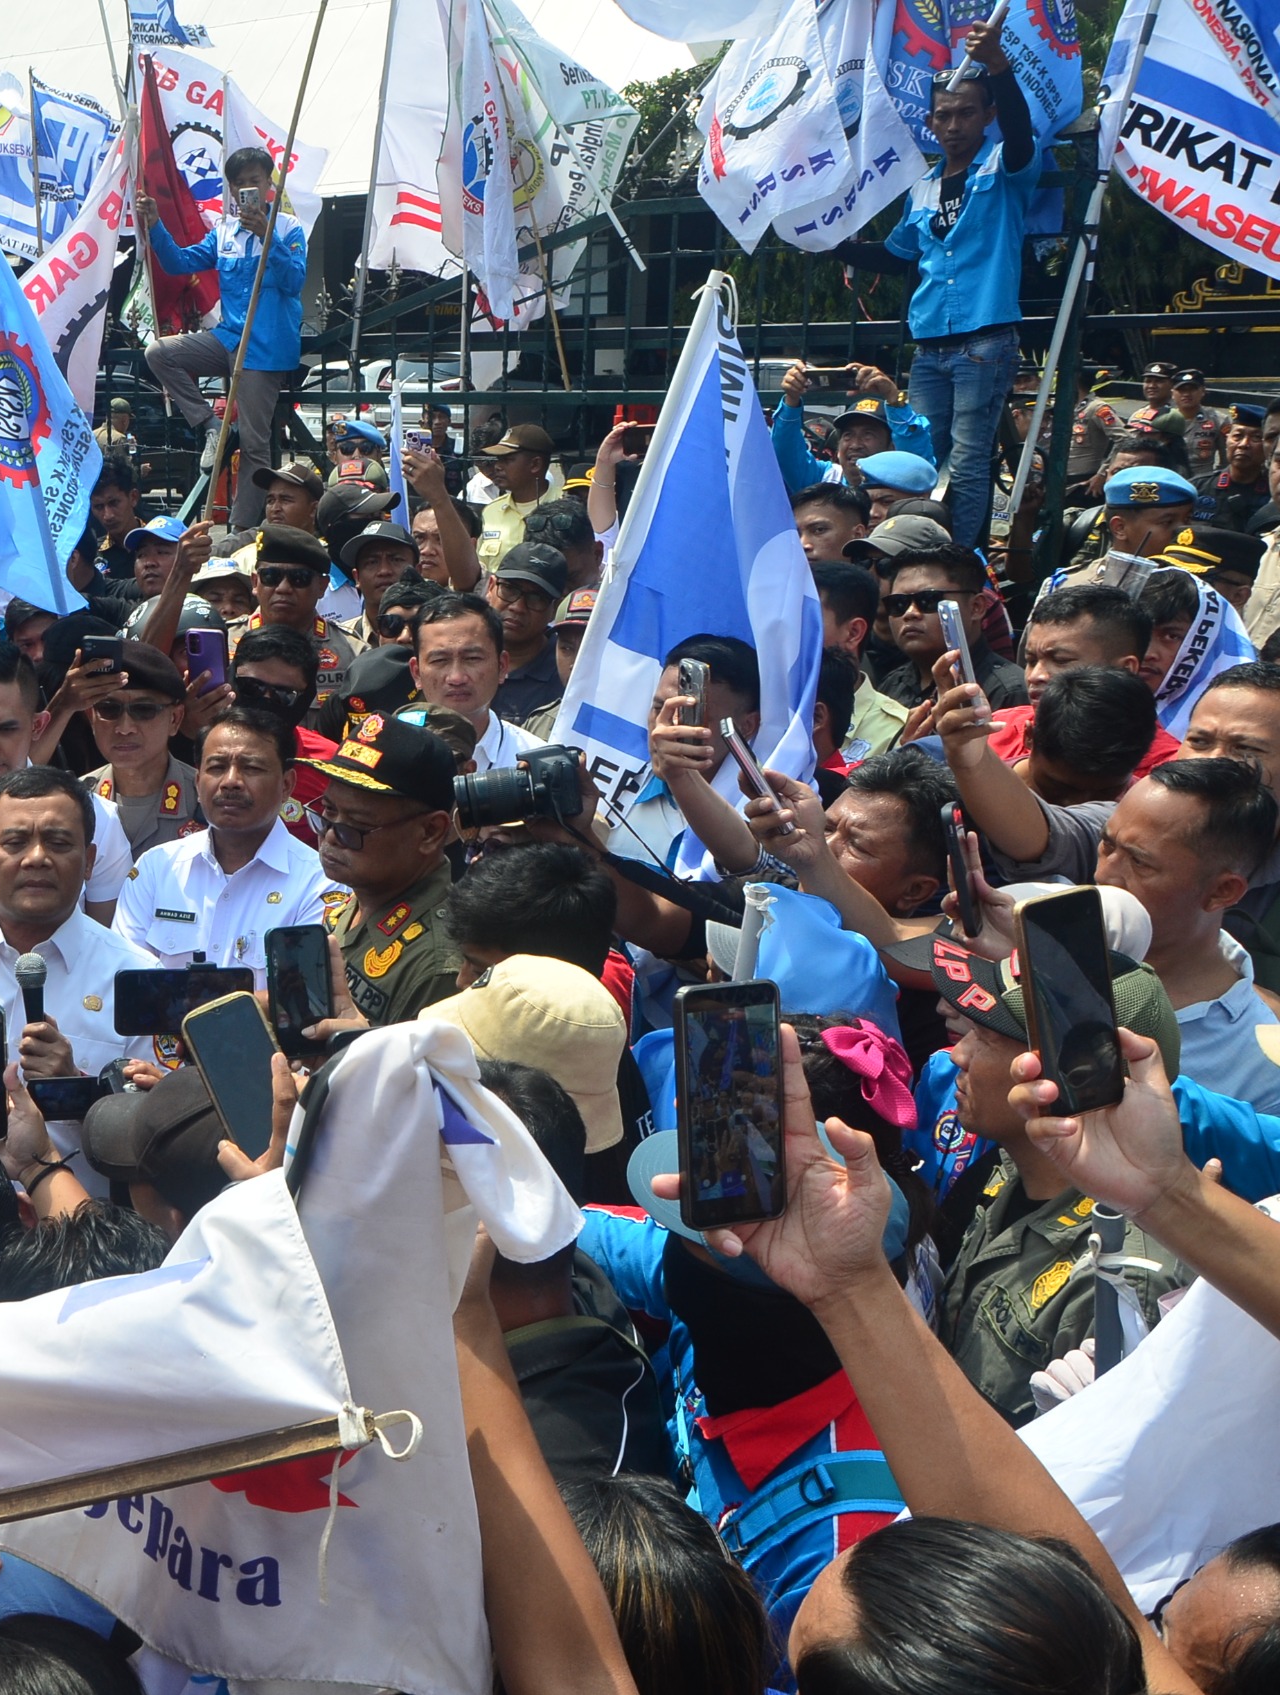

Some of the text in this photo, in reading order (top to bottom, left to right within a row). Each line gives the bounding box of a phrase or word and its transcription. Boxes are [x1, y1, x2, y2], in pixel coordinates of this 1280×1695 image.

[132, 22, 159, 33] RIKAT
[1193, 0, 1242, 65] ONESIA
[1120, 100, 1273, 190] RIKAT
[361, 986, 384, 1014] PP
